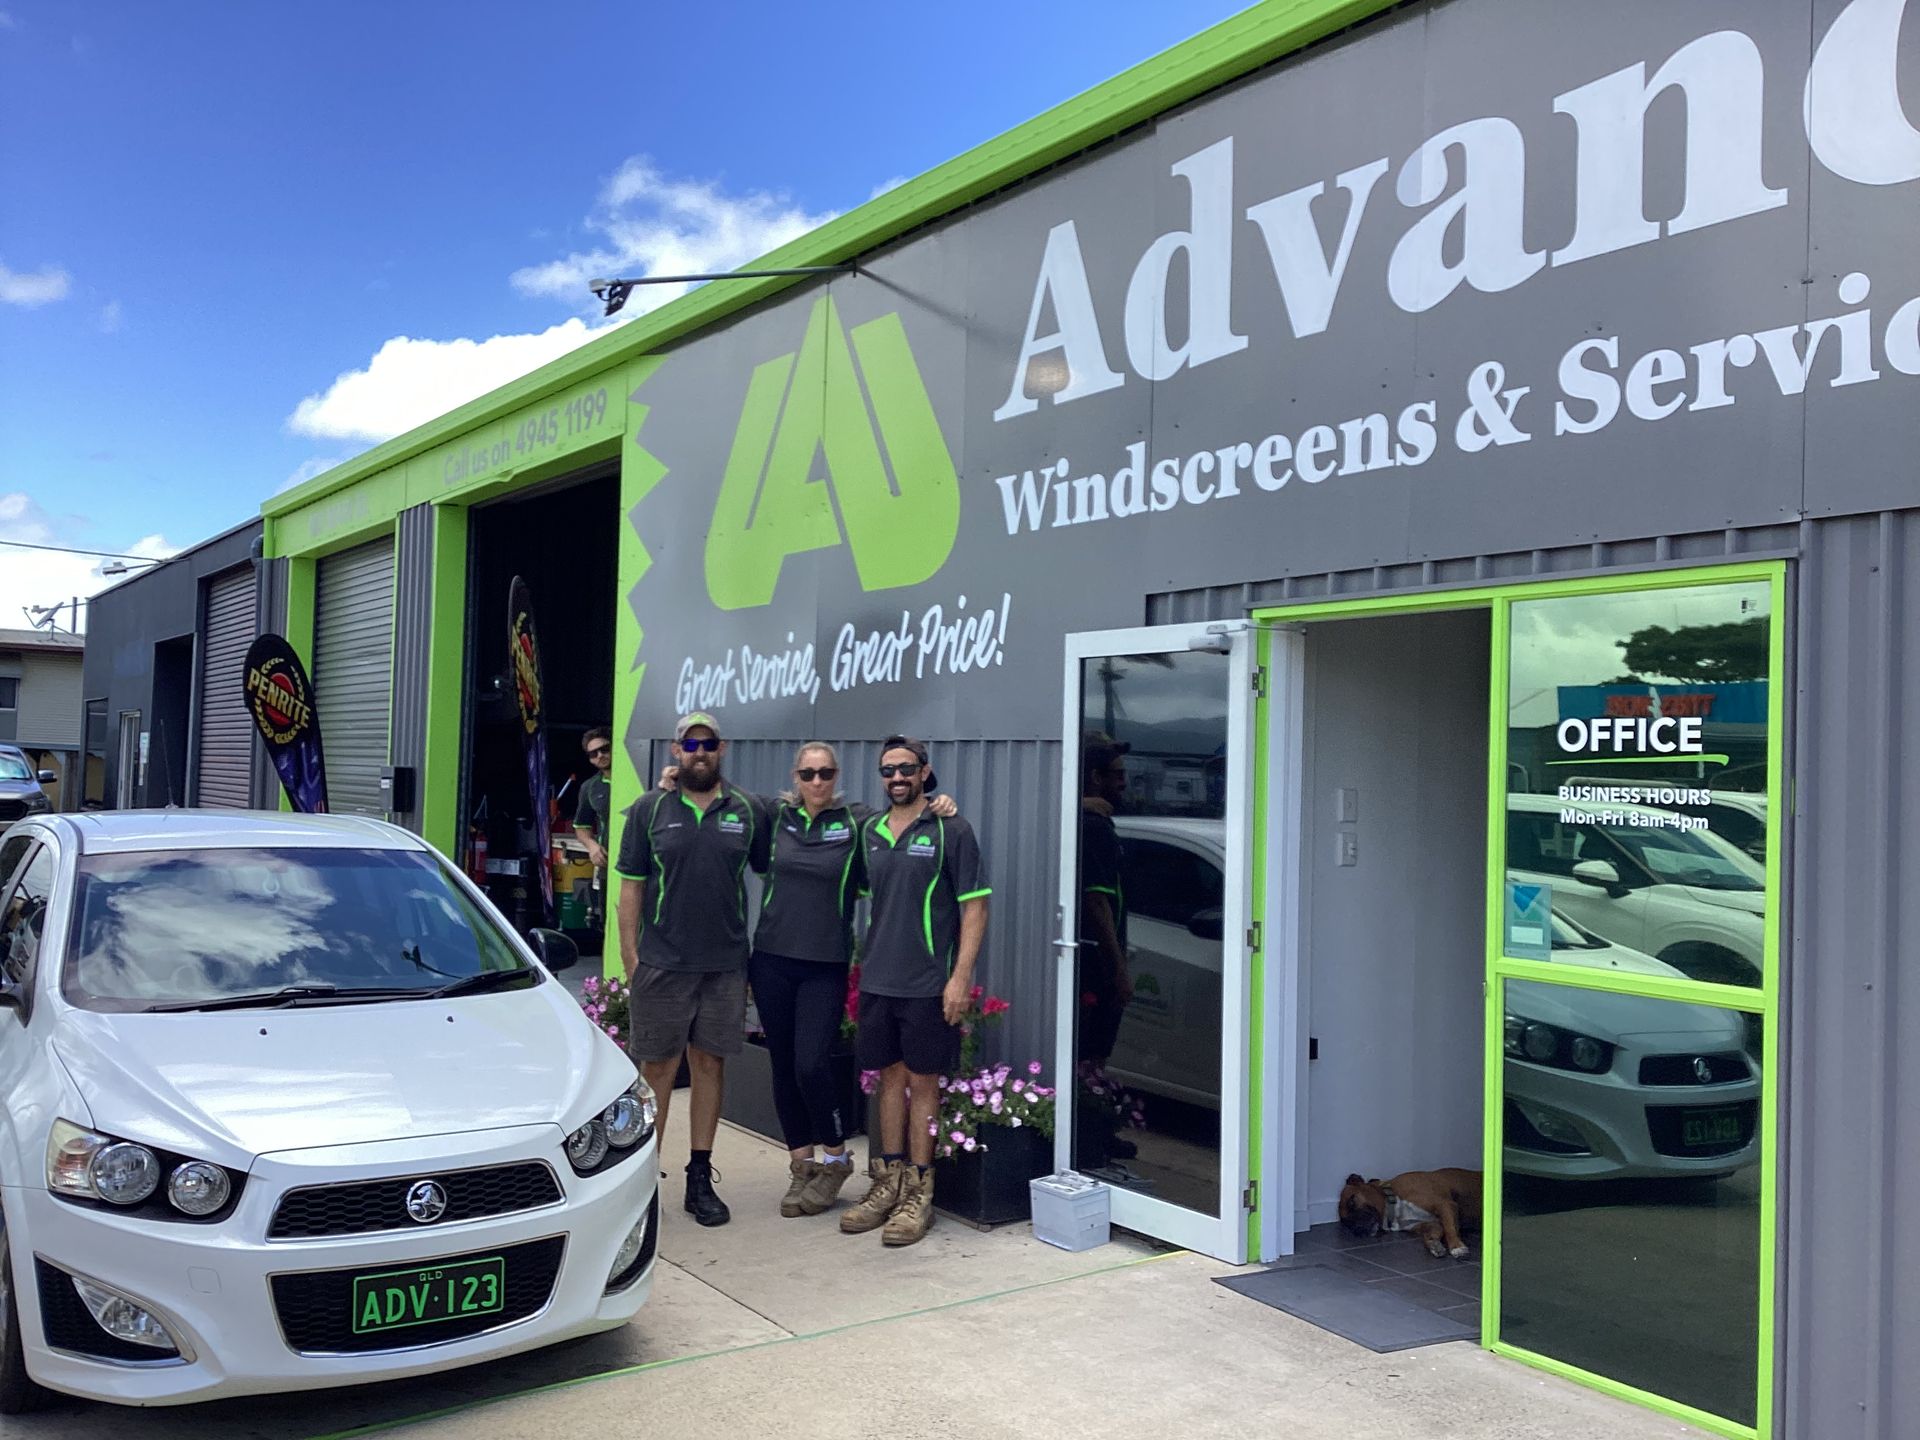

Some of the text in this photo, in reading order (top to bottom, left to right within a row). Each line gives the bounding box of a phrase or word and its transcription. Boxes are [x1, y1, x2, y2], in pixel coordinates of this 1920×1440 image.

[444, 387, 608, 486] Call us on 4945 1199
[995, 400, 1437, 535] Windscreens
[1456, 361, 1532, 452] &
[676, 592, 1011, 715] Great Service, Great Price!
[246, 667, 311, 728] PENRITE
[1557, 717, 1703, 753] OFFICE
[1559, 785, 1711, 806] BUSINESS HOURS
[1560, 808, 1709, 833] Mon-Fri 8am-4pm
[419, 1270, 444, 1282] QLD
